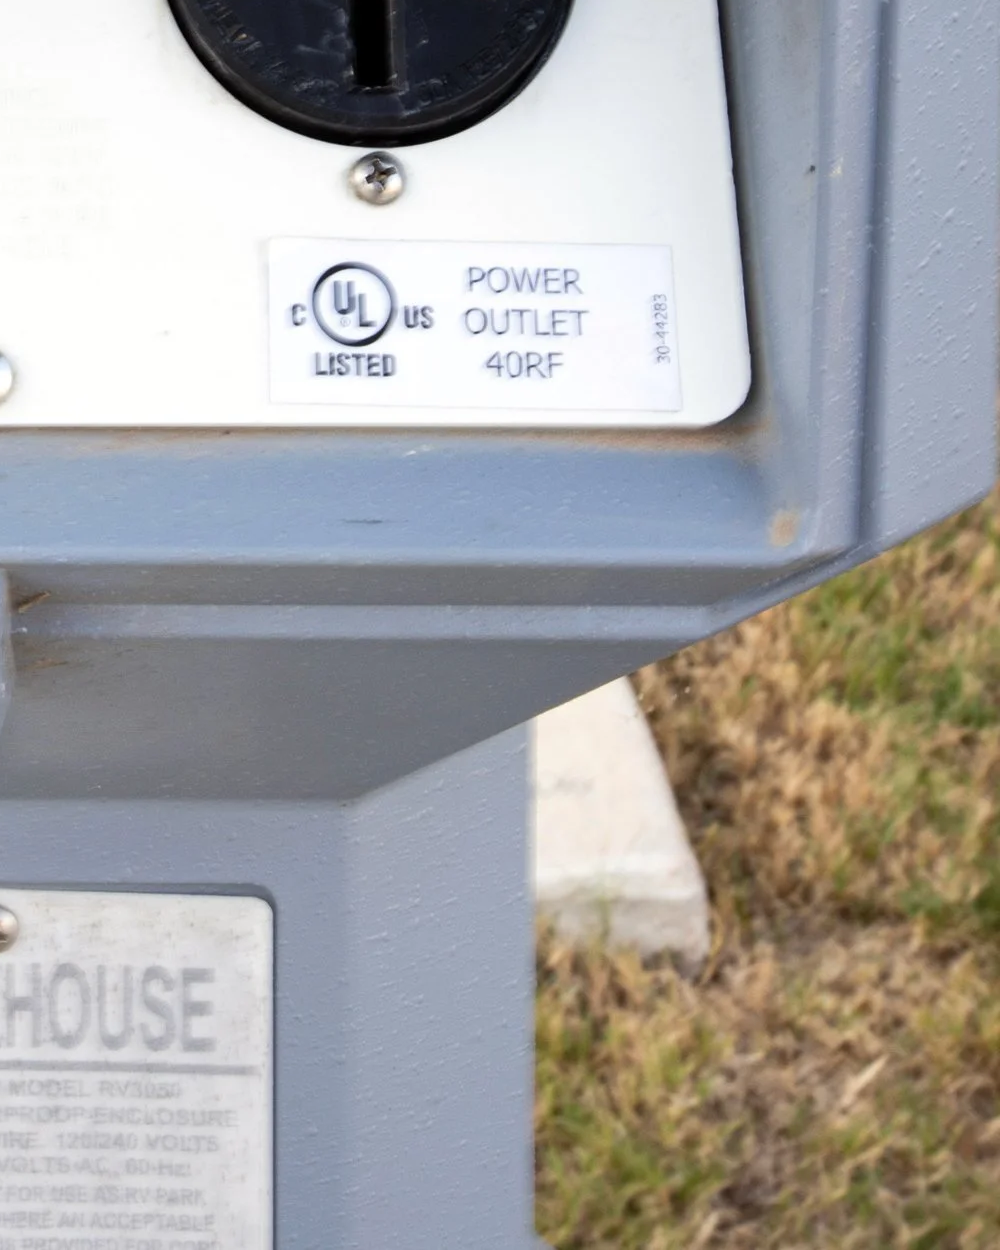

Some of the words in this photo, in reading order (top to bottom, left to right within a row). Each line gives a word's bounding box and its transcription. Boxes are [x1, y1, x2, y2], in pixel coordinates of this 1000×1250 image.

[467, 267, 584, 295] POWER
[403, 305, 434, 329] US
[463, 308, 590, 337] OUTLET
[653, 293, 671, 364] 30-44283
[315, 352, 397, 377] LISTED
[485, 351, 565, 379] 40RF
[9, 1078, 91, 1098] MODEL
[6, 1186, 46, 1203] FOR
[51, 1186, 88, 1203] USE
[95, 1186, 119, 1204] AS
[57, 1212, 85, 1229] AN
[90, 1212, 216, 1232] ACCEPTABLE
